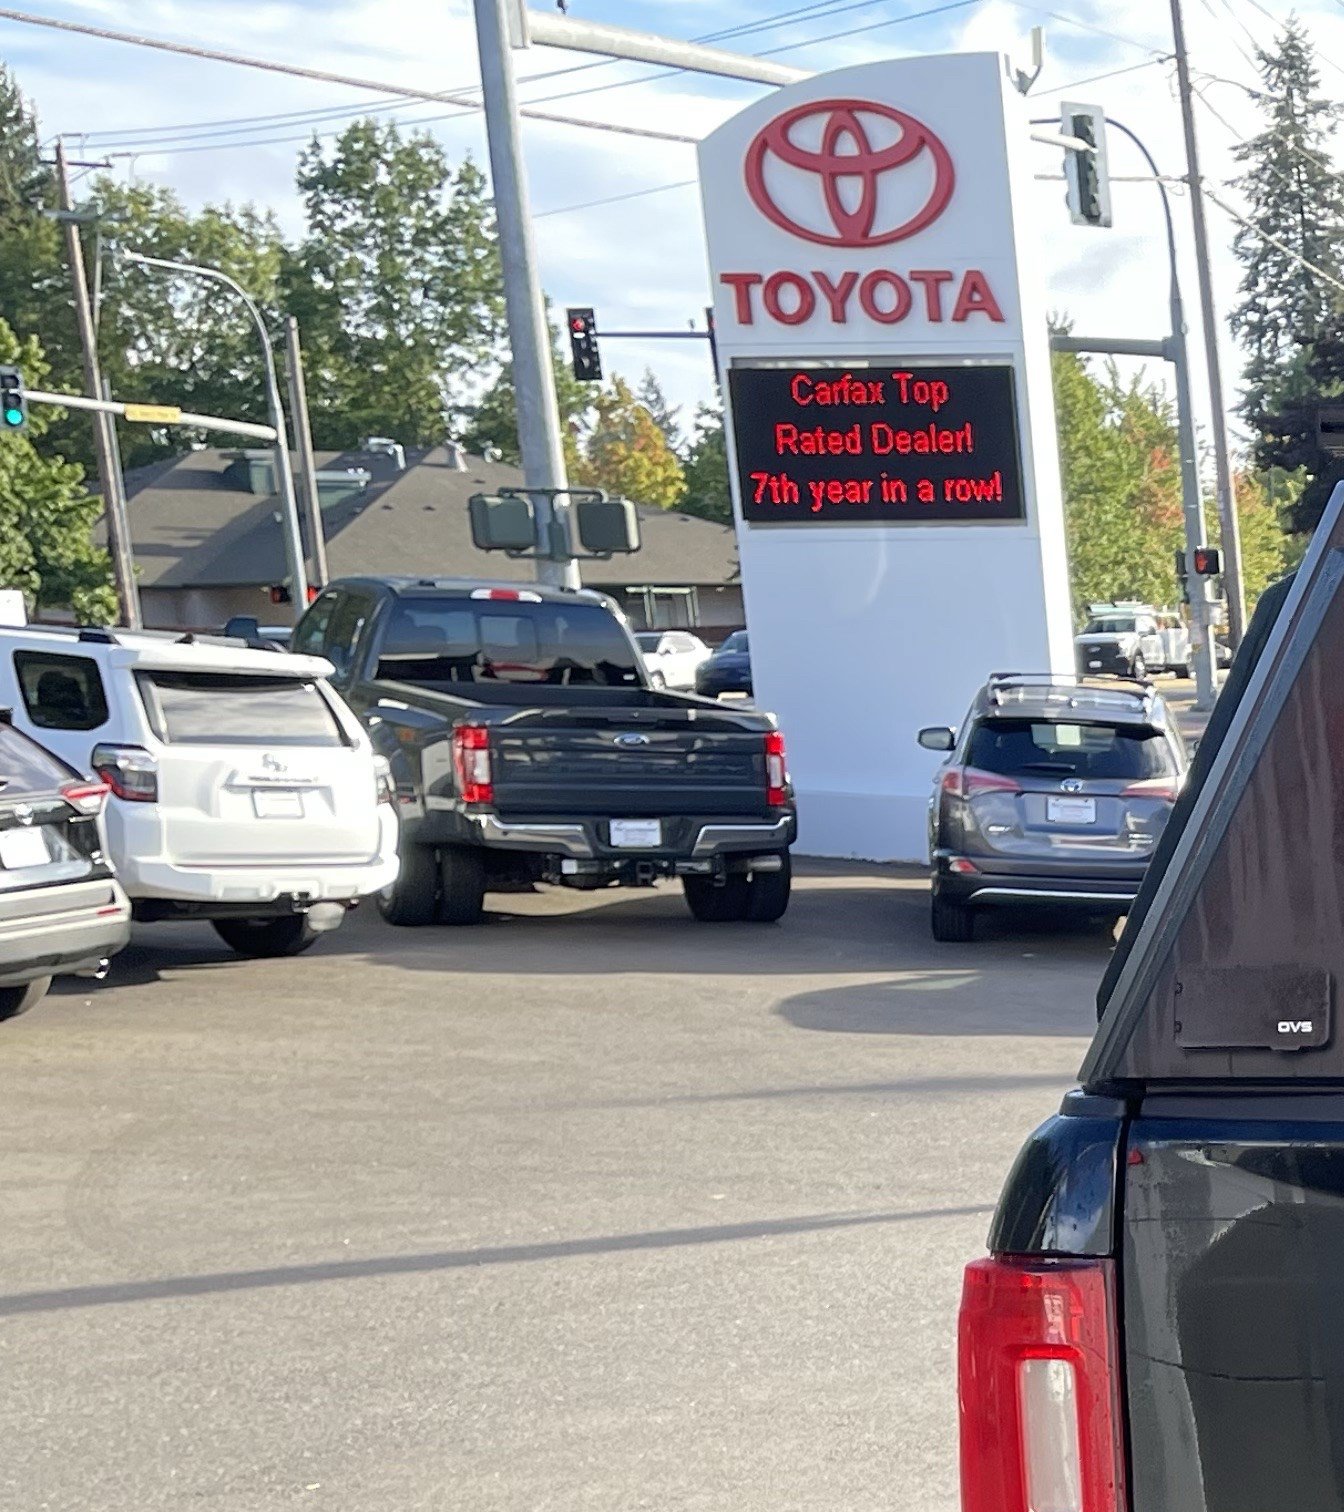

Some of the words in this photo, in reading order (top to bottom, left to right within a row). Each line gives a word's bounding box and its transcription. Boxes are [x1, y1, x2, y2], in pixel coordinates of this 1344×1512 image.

[720, 269, 1006, 326] TOYOTA
[790, 372, 886, 406] Carfax
[892, 370, 949, 413] Top
[774, 423, 863, 455] Rated
[871, 422, 973, 454] Dealer!
[750, 471, 799, 504] 7th
[808, 480, 873, 512] year
[880, 471, 907, 503] in
[916, 479, 936, 504] a
[944, 470, 1003, 502] row!
[1277, 1020, 1313, 1033] OVS
